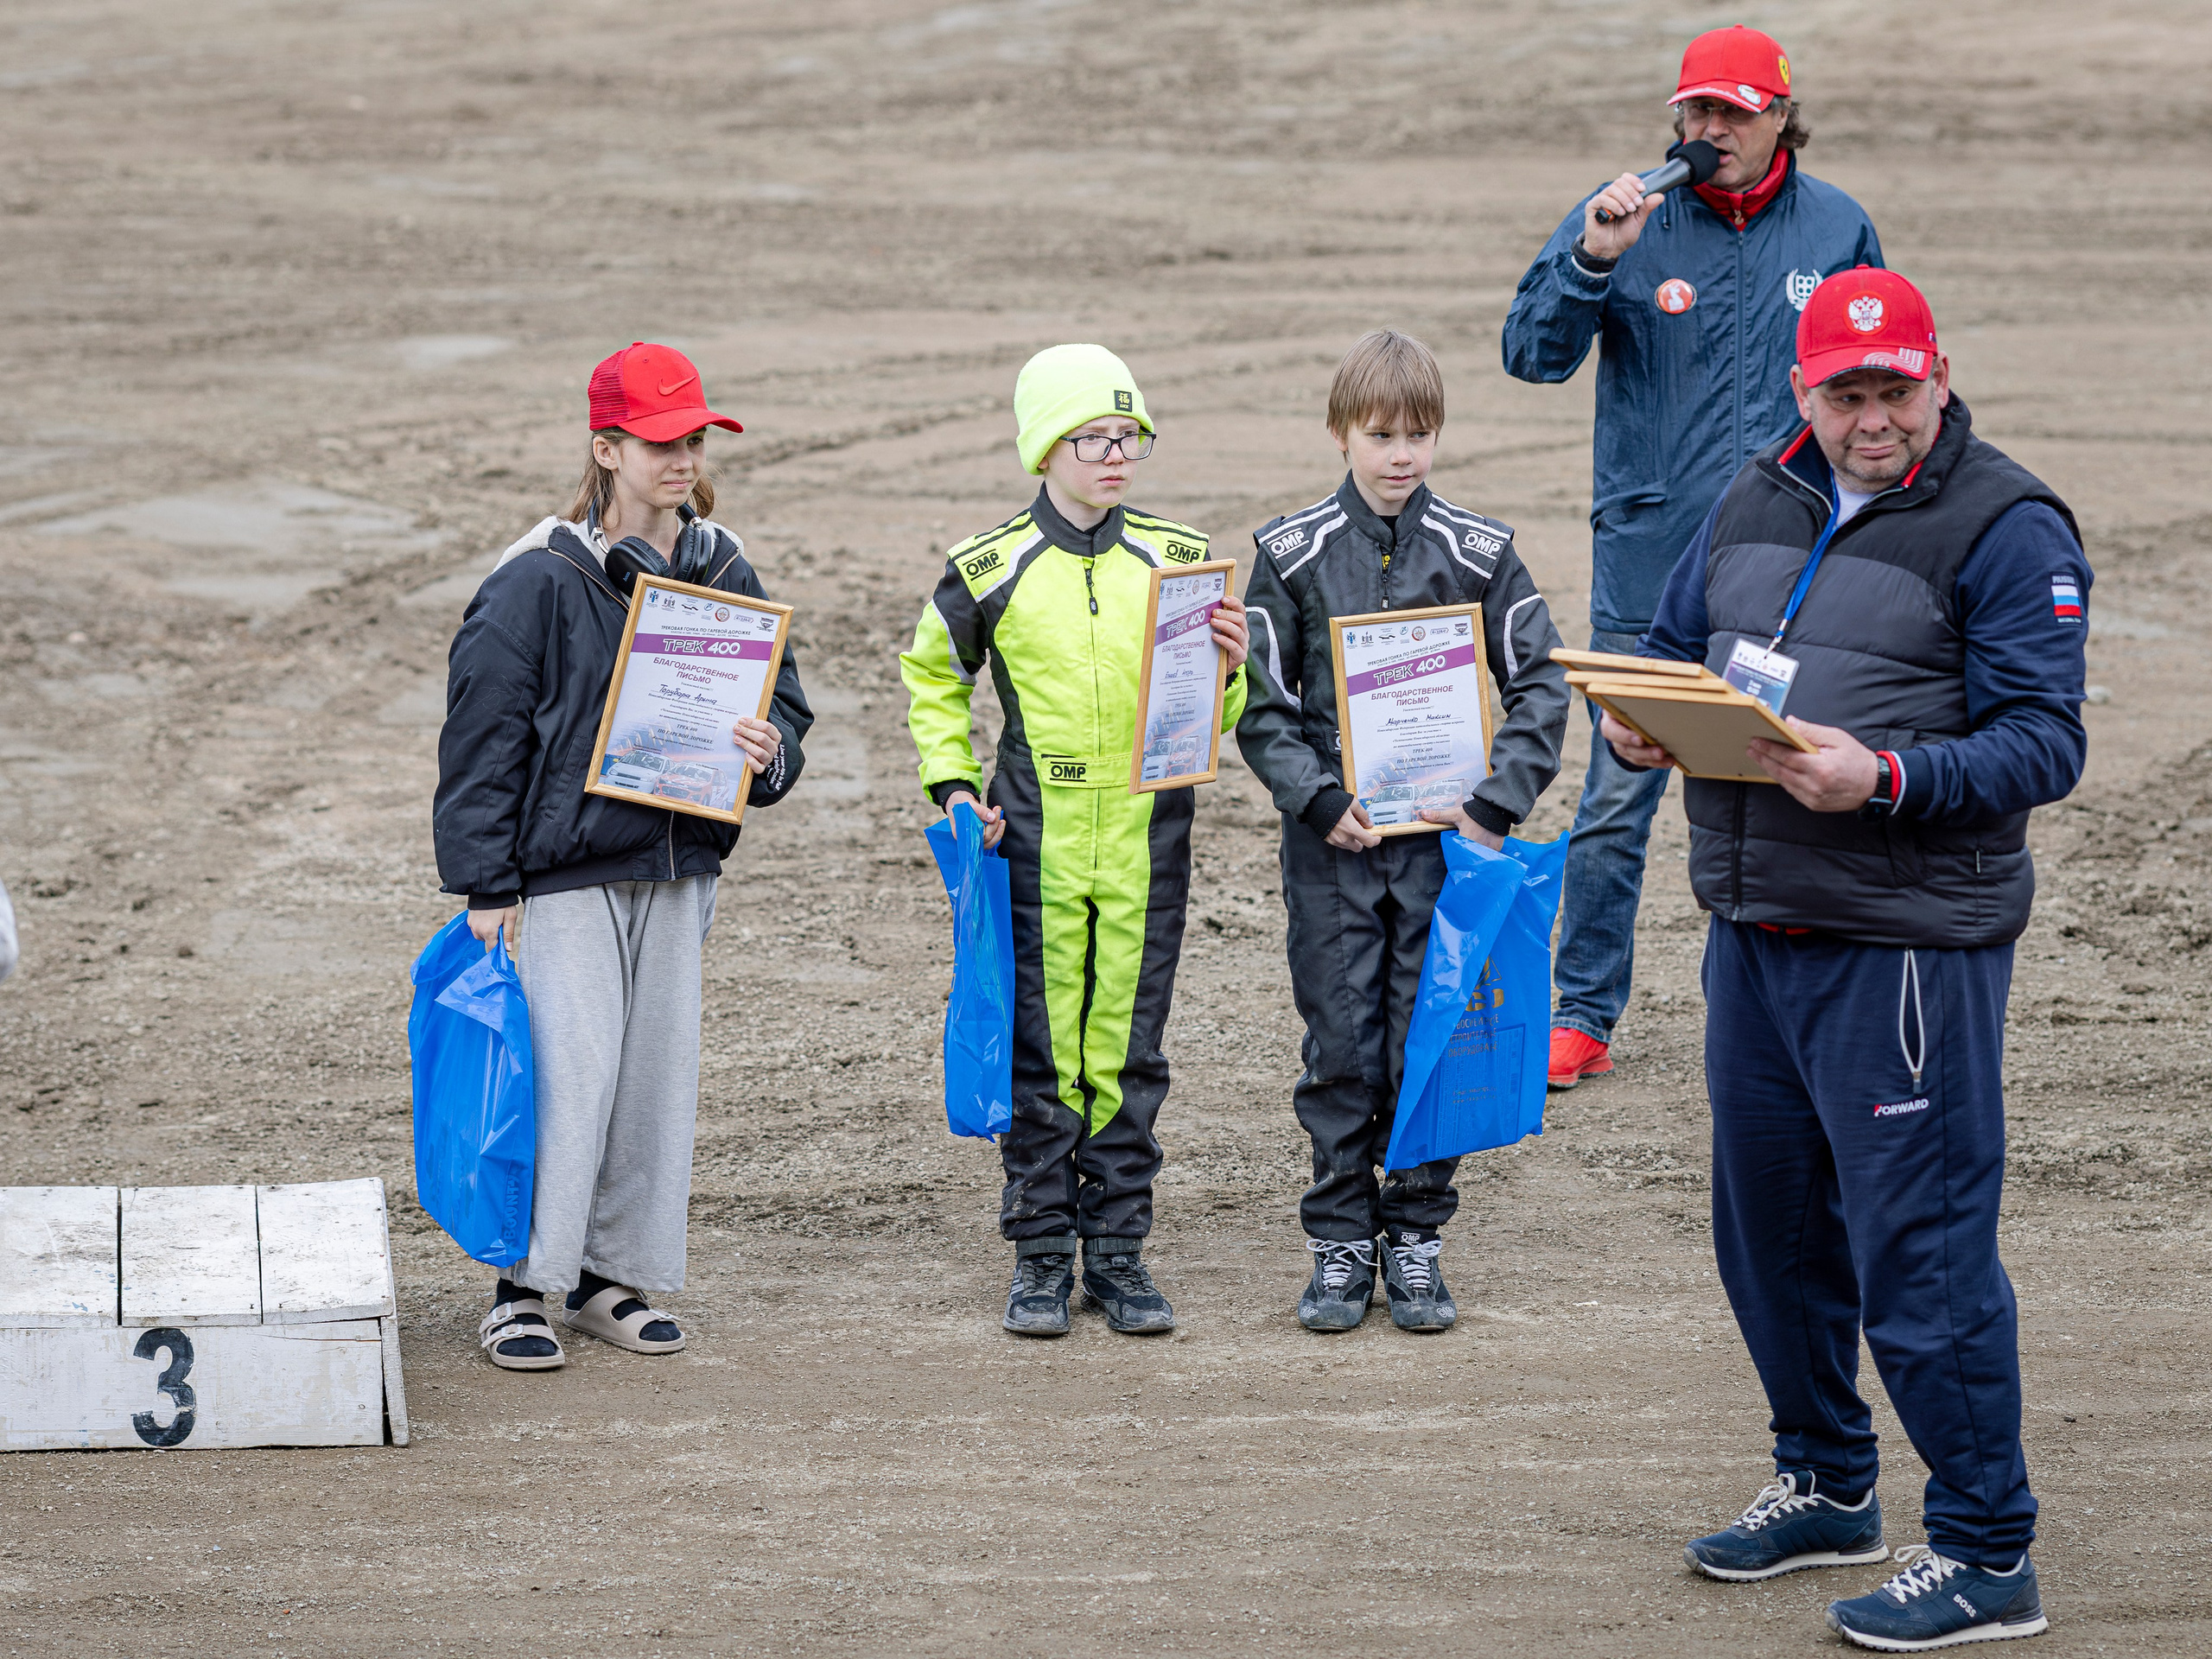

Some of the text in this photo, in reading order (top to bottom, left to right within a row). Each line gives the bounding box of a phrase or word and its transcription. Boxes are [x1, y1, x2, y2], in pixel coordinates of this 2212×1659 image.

[1271, 531, 1305, 554] OMP
[1465, 533, 1501, 554] OMP
[1166, 543, 1200, 563] OMP
[966, 552, 1000, 576] OMP
[1166, 610, 1205, 638] ТРЕК 400
[663, 639, 741, 655] ТРЕК 400
[1162, 640, 1205, 652] БЛАГОДАРСТВЕННОЕ
[1368, 658, 1388, 666] ТРЕКОВАЯ
[1410, 646, 1428, 655] ГАРЕВОЙ
[1429, 641, 1451, 650] ДОРОЖКЕ
[653, 658, 740, 682] БЛАГОДАРСТВЕННОЕ
[677, 671, 711, 684] ПИСЬМО
[1374, 654, 1446, 686] ТРЕК 400
[1371, 685, 1453, 700] БЛАГОДАРСТВЕННОЕ
[1396, 696, 1429, 706] ПИСЬМО
[1386, 717, 1418, 726] Марченко
[1051, 765, 1086, 779] OMP
[1874, 1097, 1929, 1117] FORWARD
[130, 1328, 197, 1447] 3
[1953, 1593, 1977, 1618] BOSS
